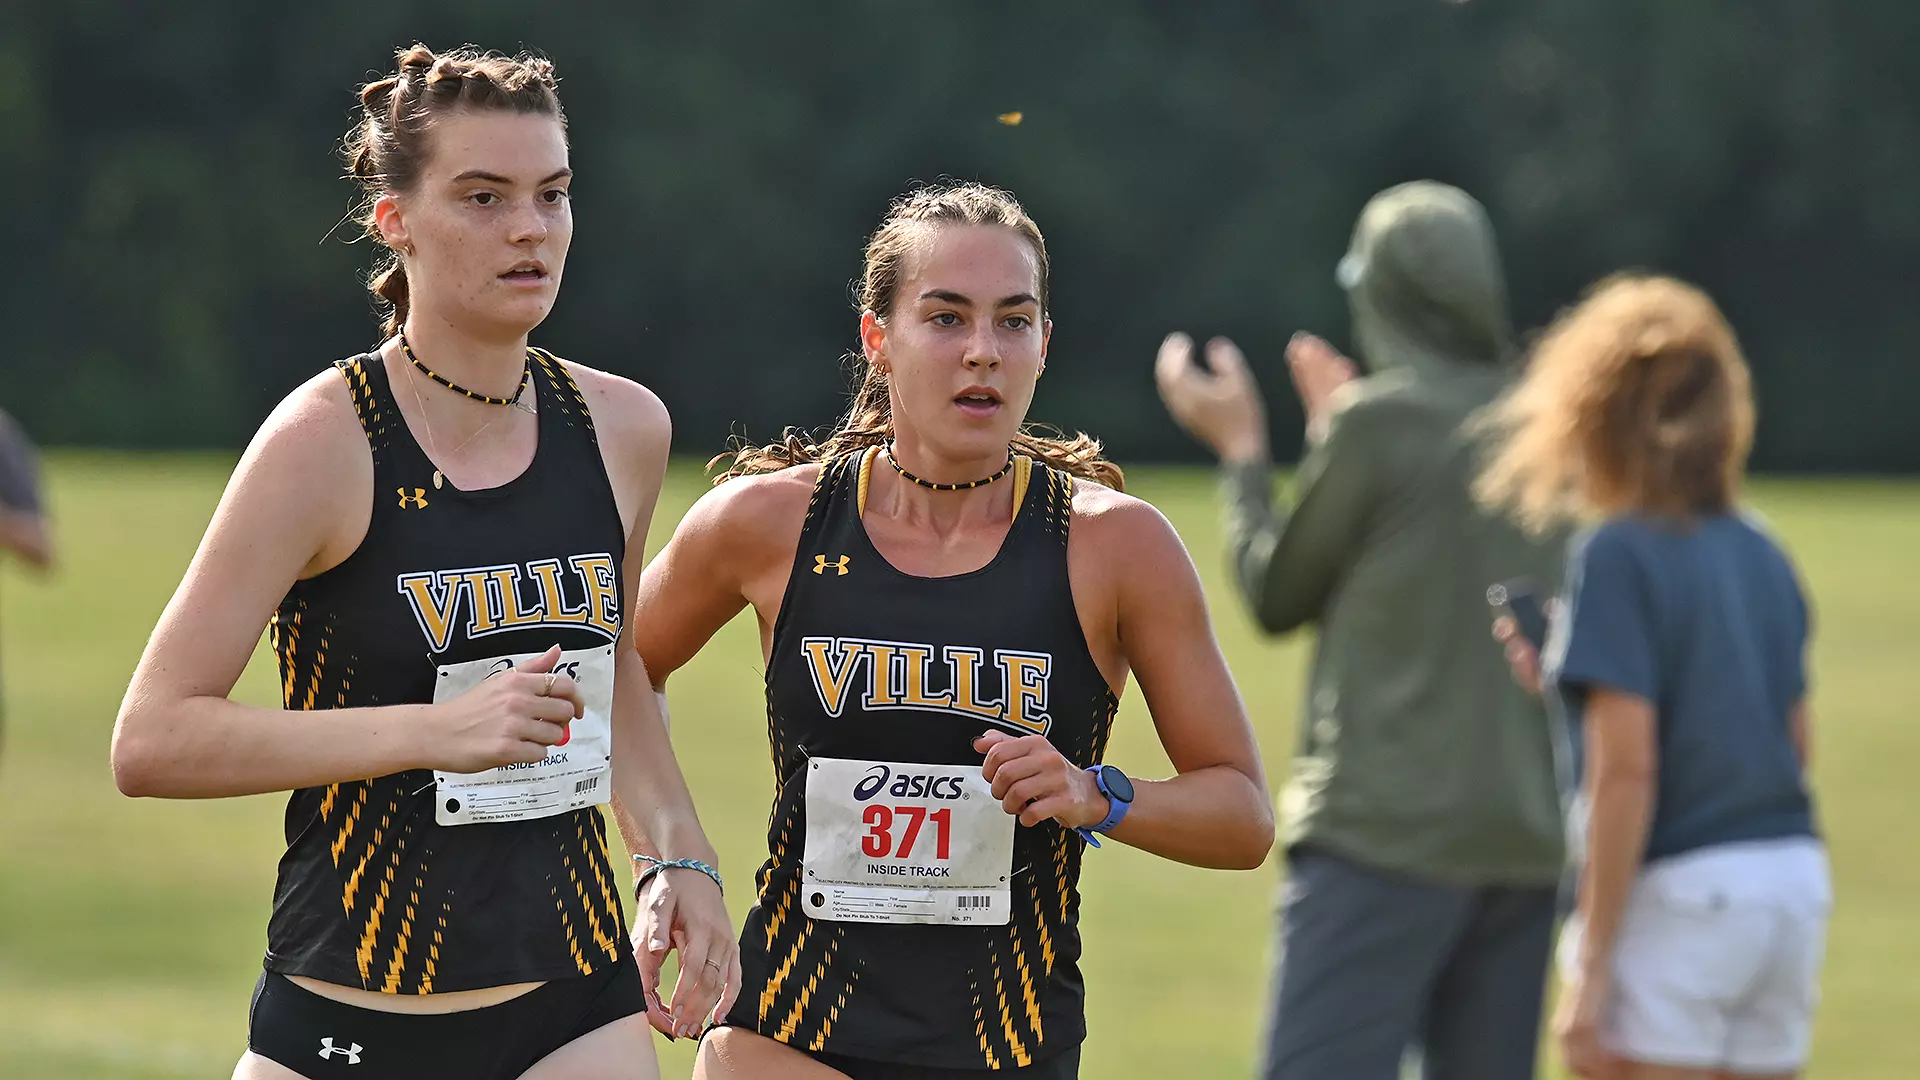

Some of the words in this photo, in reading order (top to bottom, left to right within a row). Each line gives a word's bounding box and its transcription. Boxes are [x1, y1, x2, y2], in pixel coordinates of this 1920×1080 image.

[397, 553, 618, 653] VILLE
[801, 637, 1053, 737] VILLE
[862, 804, 951, 860] 371
[867, 864, 907, 876] INSIDE
[909, 866, 950, 878] TRACK
